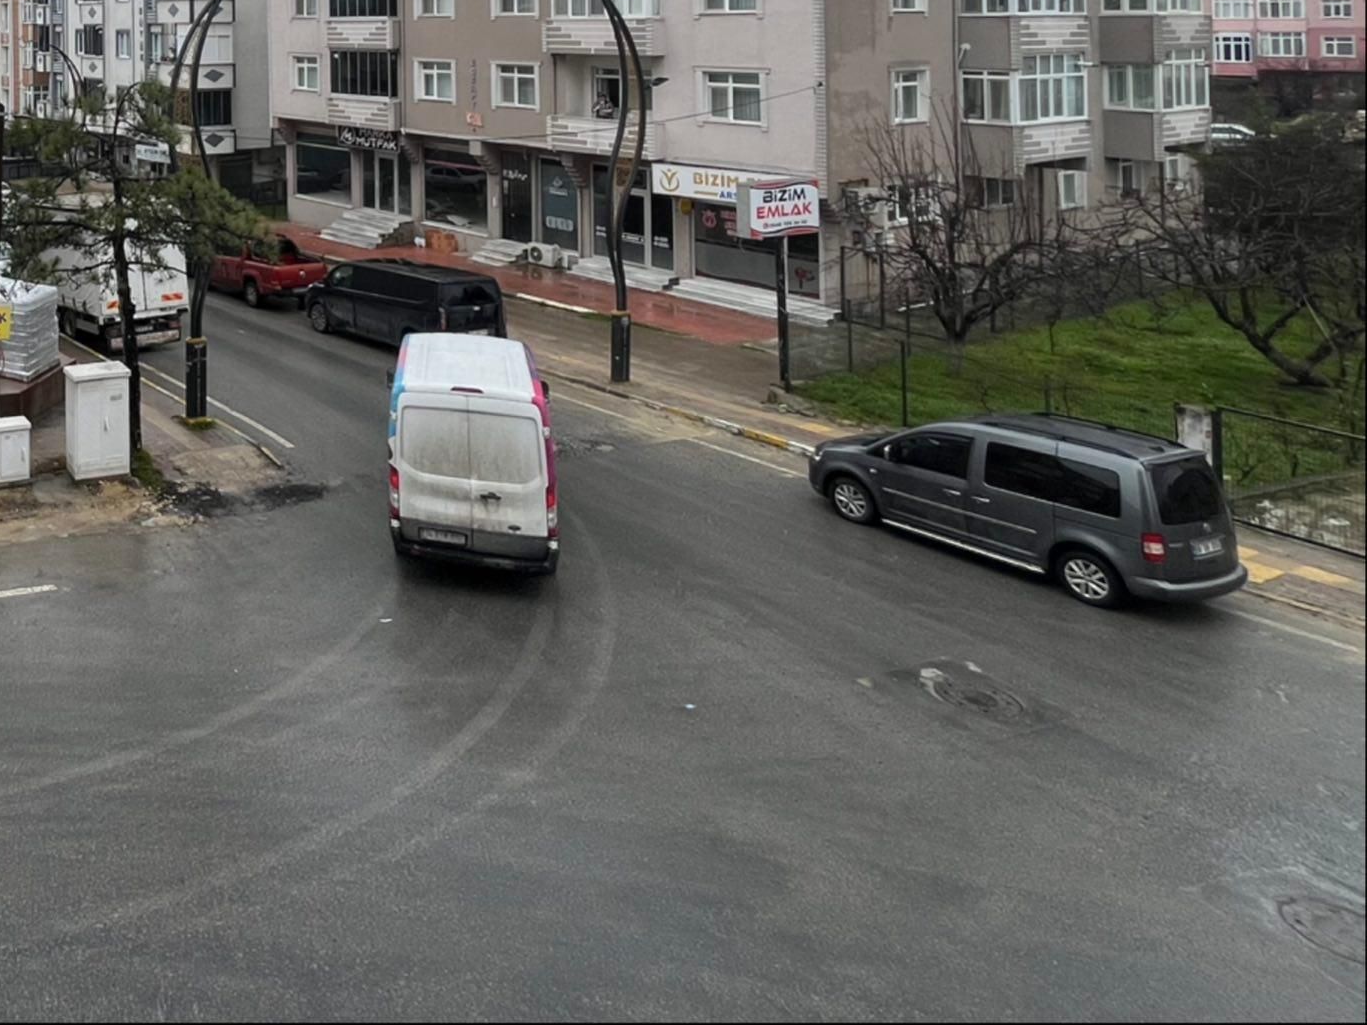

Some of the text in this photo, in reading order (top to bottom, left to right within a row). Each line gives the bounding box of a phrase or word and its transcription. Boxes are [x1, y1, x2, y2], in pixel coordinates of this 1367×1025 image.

[356, 137, 396, 151] MUTFAK
[693, 170, 738, 188] BİZİM
[756, 202, 812, 219] EMLAK
